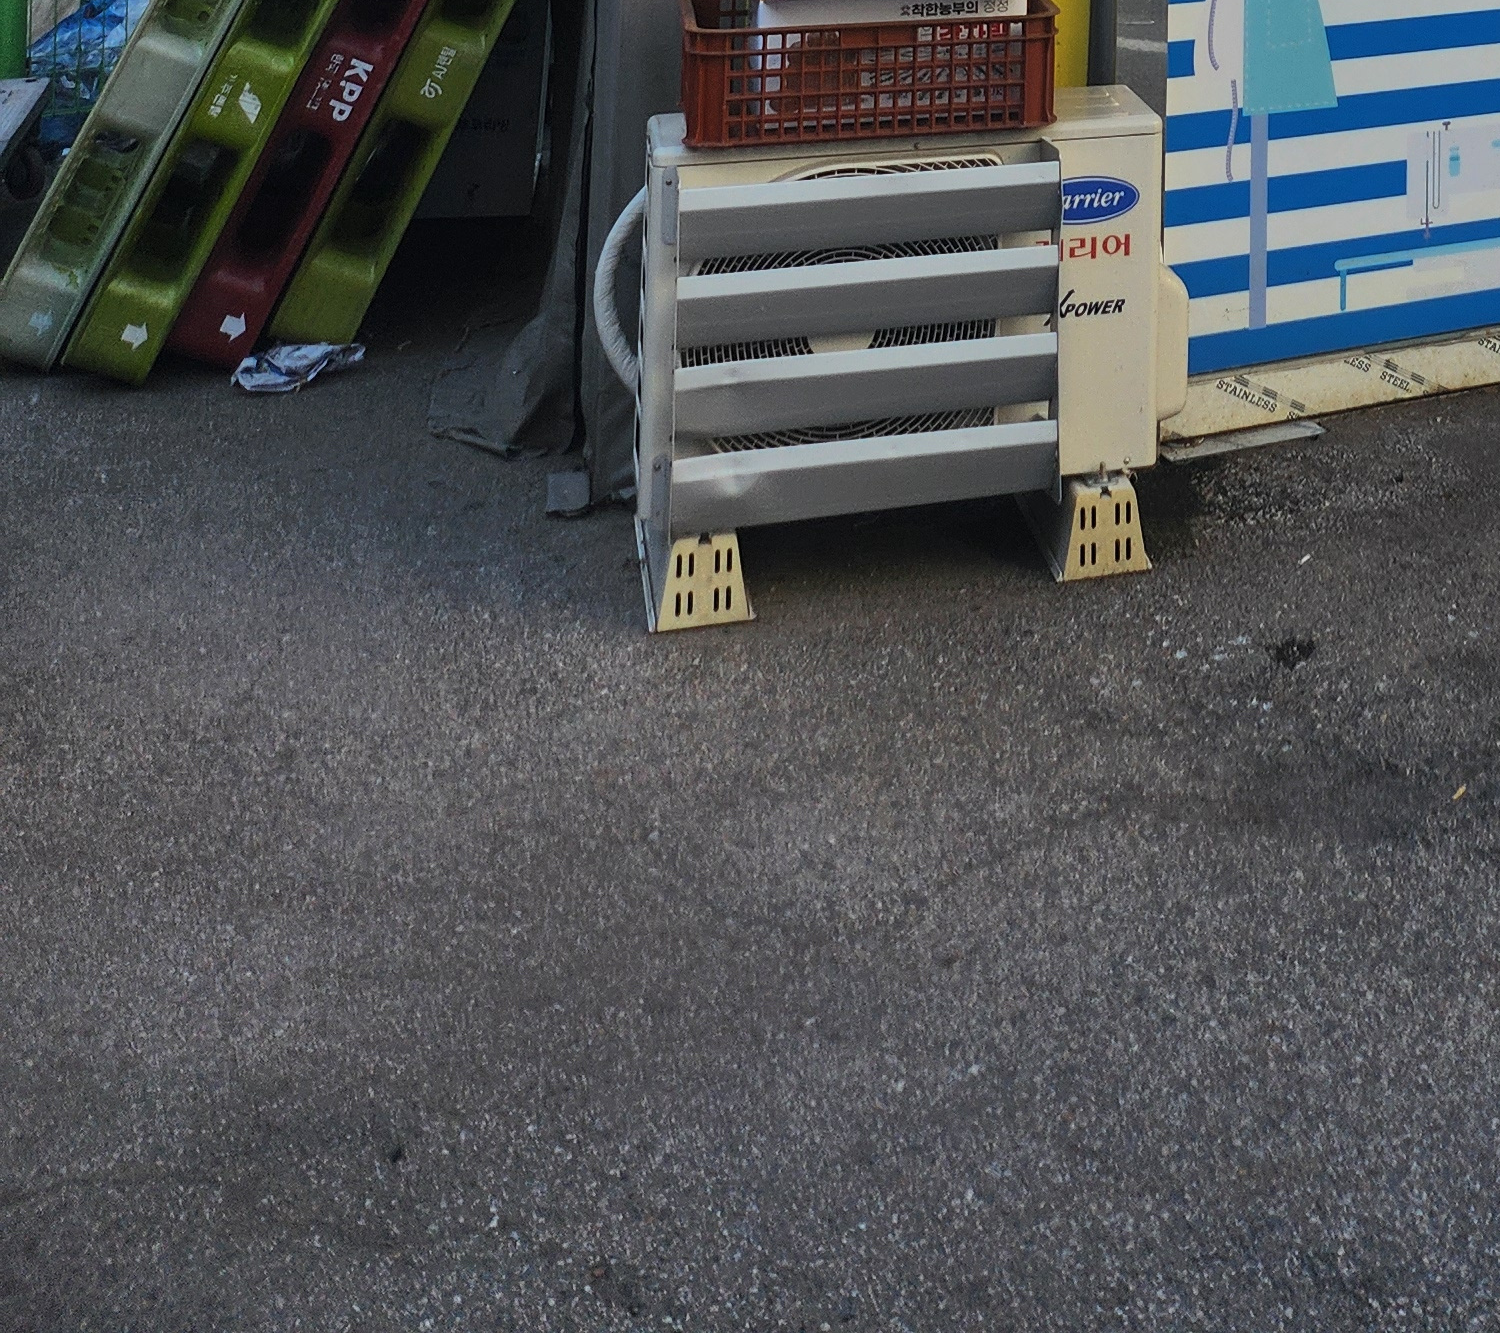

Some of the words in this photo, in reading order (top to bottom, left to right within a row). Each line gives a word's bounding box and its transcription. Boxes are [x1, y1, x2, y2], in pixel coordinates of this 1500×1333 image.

[911, 0, 979, 17] 착한농부의
[983, 0, 1009, 14] 정성
[328, 57, 375, 123] KPP
[1062, 187, 1126, 211] arrier
[1216, 378, 1279, 414] STAINLESS
